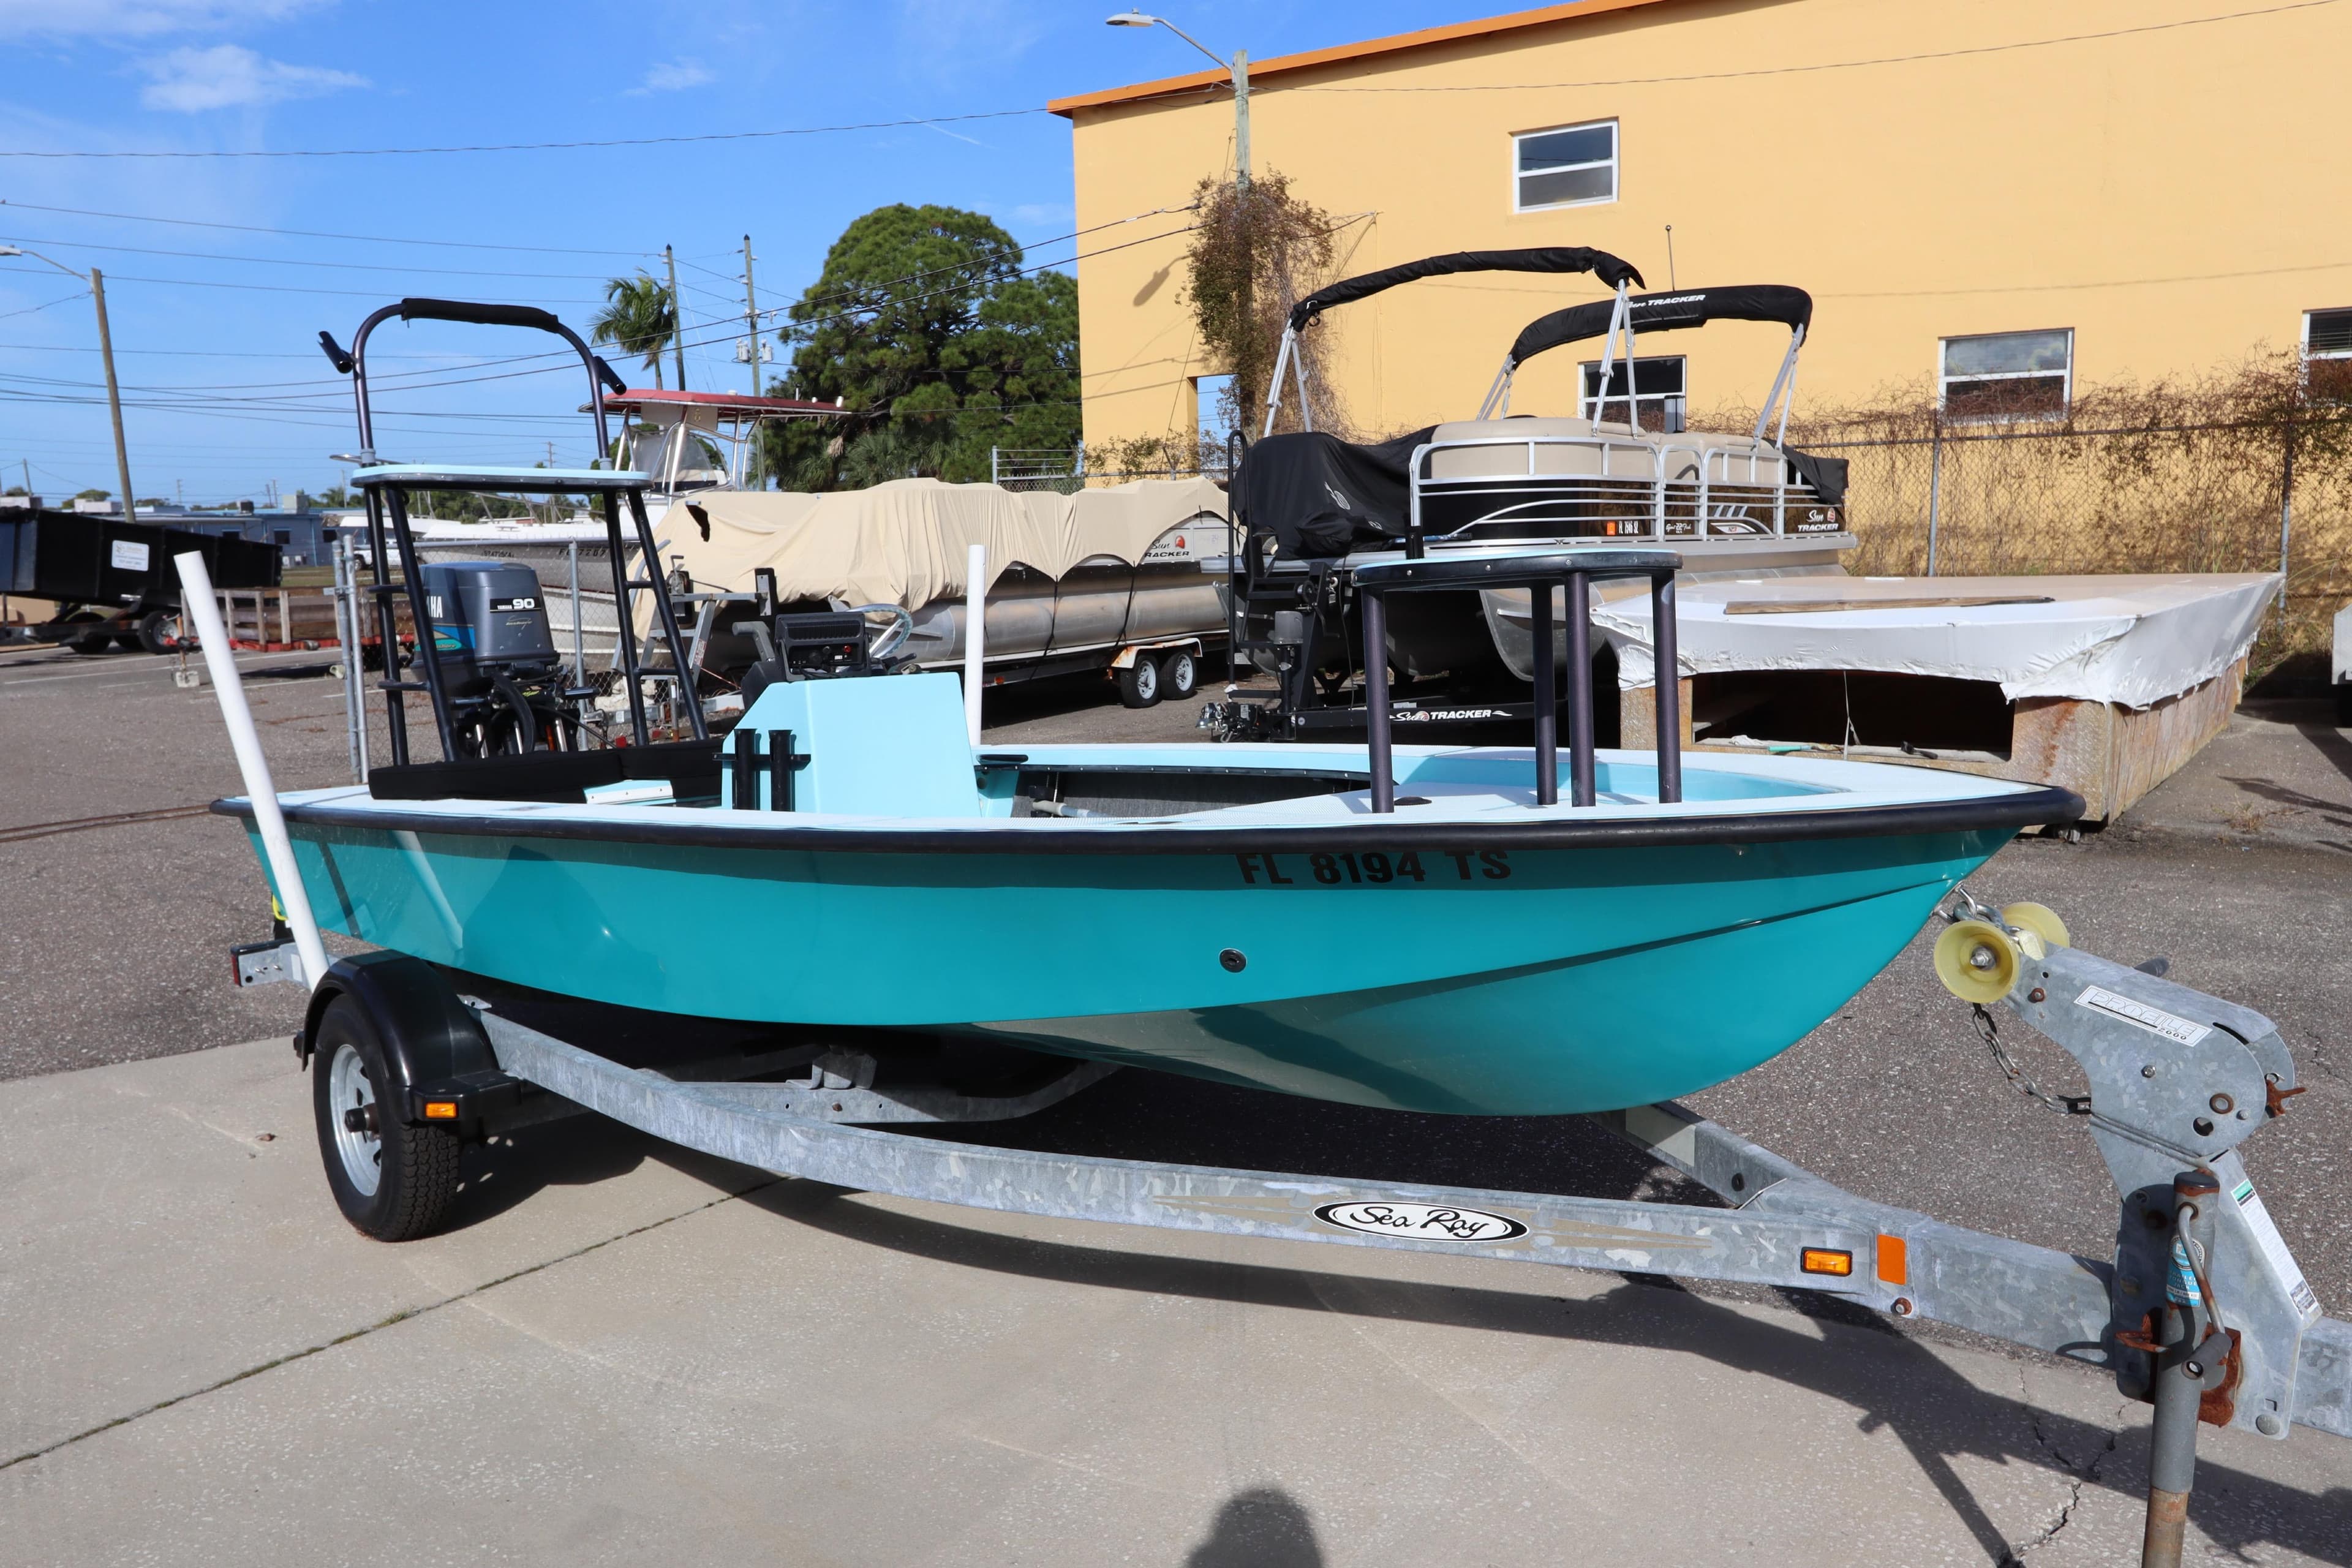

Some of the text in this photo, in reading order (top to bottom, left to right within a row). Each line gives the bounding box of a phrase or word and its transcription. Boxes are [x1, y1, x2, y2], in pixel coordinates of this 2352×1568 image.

[1648, 295, 1706, 306] TRACKER
[1806, 510, 1825, 522] Sun
[1797, 523, 1839, 532] TRACKER
[1151, 539, 1170, 549] Sun
[513, 598, 535, 609] 90
[1393, 709, 1491, 722] Sun TRACKER
[1235, 849, 1512, 884] FL 8194 TS
[2089, 991, 2198, 1037] PROFILE
[2157, 1027, 2187, 1041] 2000
[1349, 1206, 1490, 1238] Sea Ray
